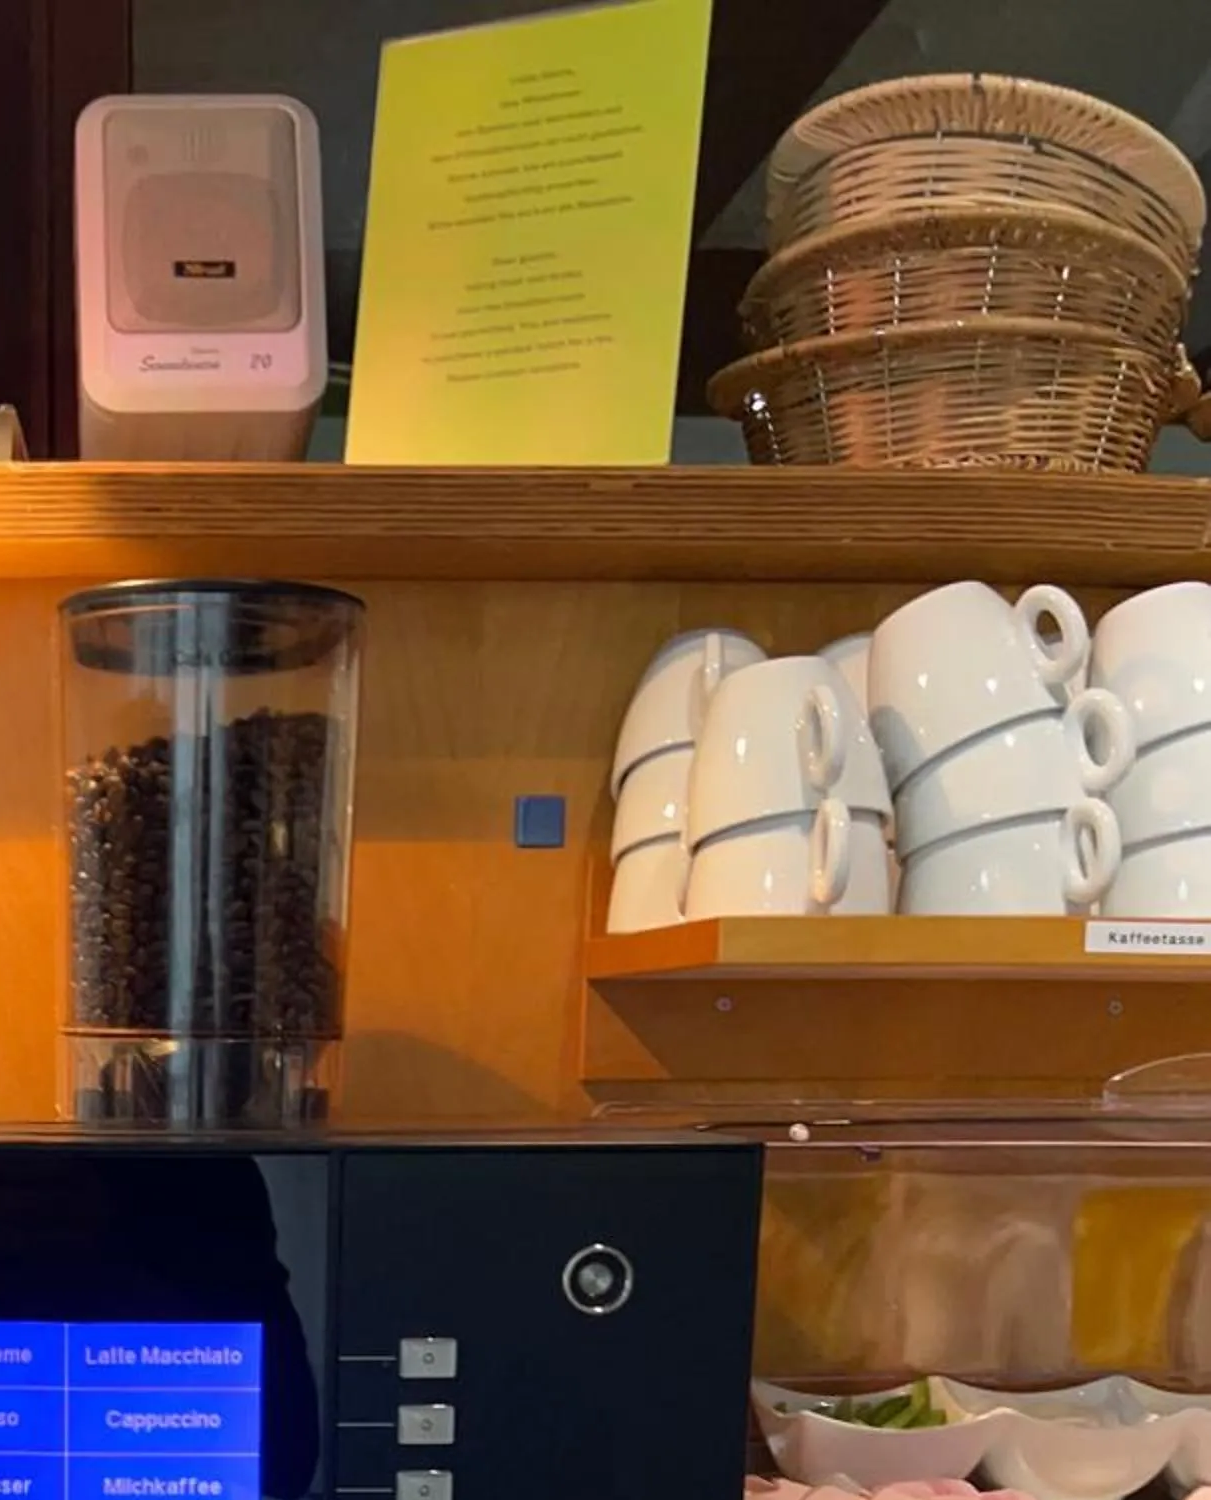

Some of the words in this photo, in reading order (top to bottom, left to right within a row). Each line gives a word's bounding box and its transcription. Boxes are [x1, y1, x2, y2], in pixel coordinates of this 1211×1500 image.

[1108, 931, 1205, 945] Kaffeetasse
[85, 1346, 137, 1365] Latte
[141, 1346, 243, 1366] Macchiato
[105, 1410, 221, 1433] Cappuccino
[103, 1477, 223, 1496] Milchkaffee
